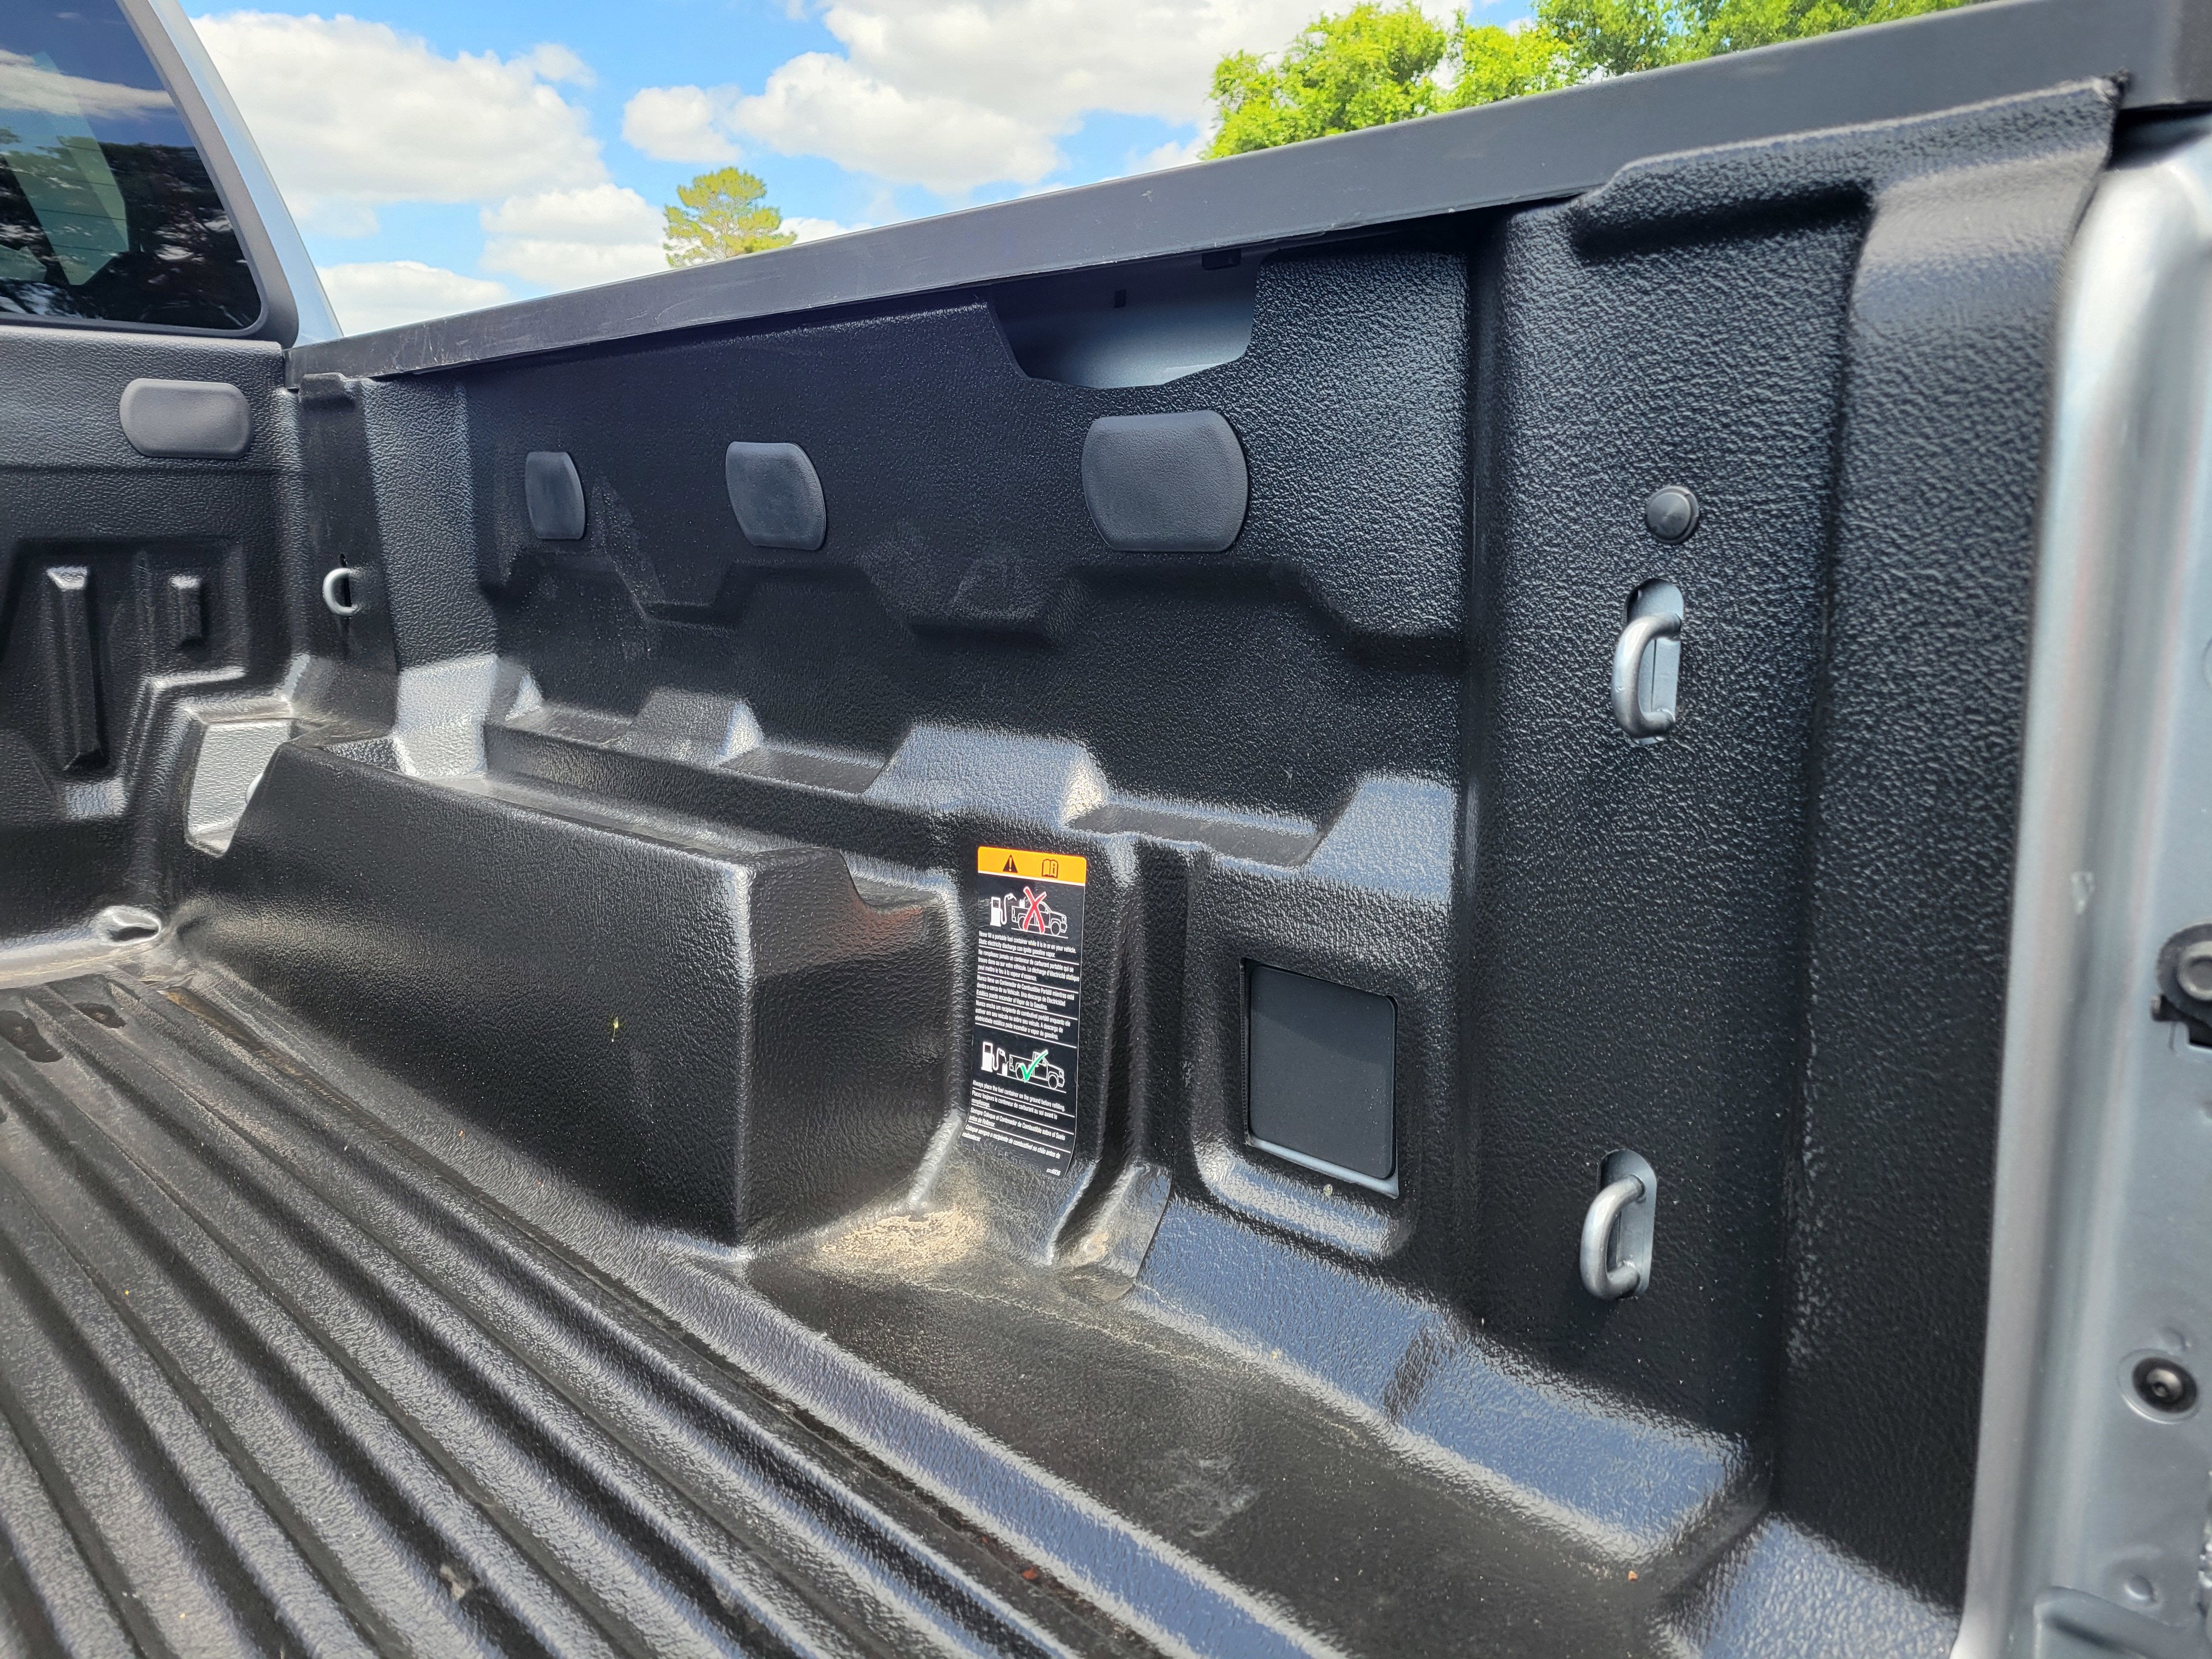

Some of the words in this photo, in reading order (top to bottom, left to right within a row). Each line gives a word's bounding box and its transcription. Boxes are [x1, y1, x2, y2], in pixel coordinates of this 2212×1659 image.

[988, 940, 1002, 949] electricity
[1002, 943, 1017, 951] discharge
[1000, 979, 1017, 988] Contenedor
[1022, 984, 1040, 994] Combustible
[1052, 991, 1066, 999] mientras
[1028, 993, 1041, 1001] descarga
[1047, 997, 1065, 1007] Electricidad
[975, 1015, 992, 1024] eletricidade
[1013, 1024, 1028, 1032] incendiar
[1043, 1023, 1058, 1032] descarga
[973, 1080, 983, 1088] Always
[1004, 1090, 1019, 1098] container
[1041, 1099, 1051, 1107] before
[982, 1093, 994, 1102] toujours
[1019, 1104, 1034, 1113] carburant
[970, 1107, 983, 1116] Siempre
[983, 1111, 995, 1120] Coloque
[1000, 1116, 1017, 1126] Contenedor
[1022, 1122, 1042, 1133] Combustible
[966, 1124, 978, 1133] Coloque
[978, 1128, 990, 1137] sempre
[992, 1133, 1008, 1143] recipiente
